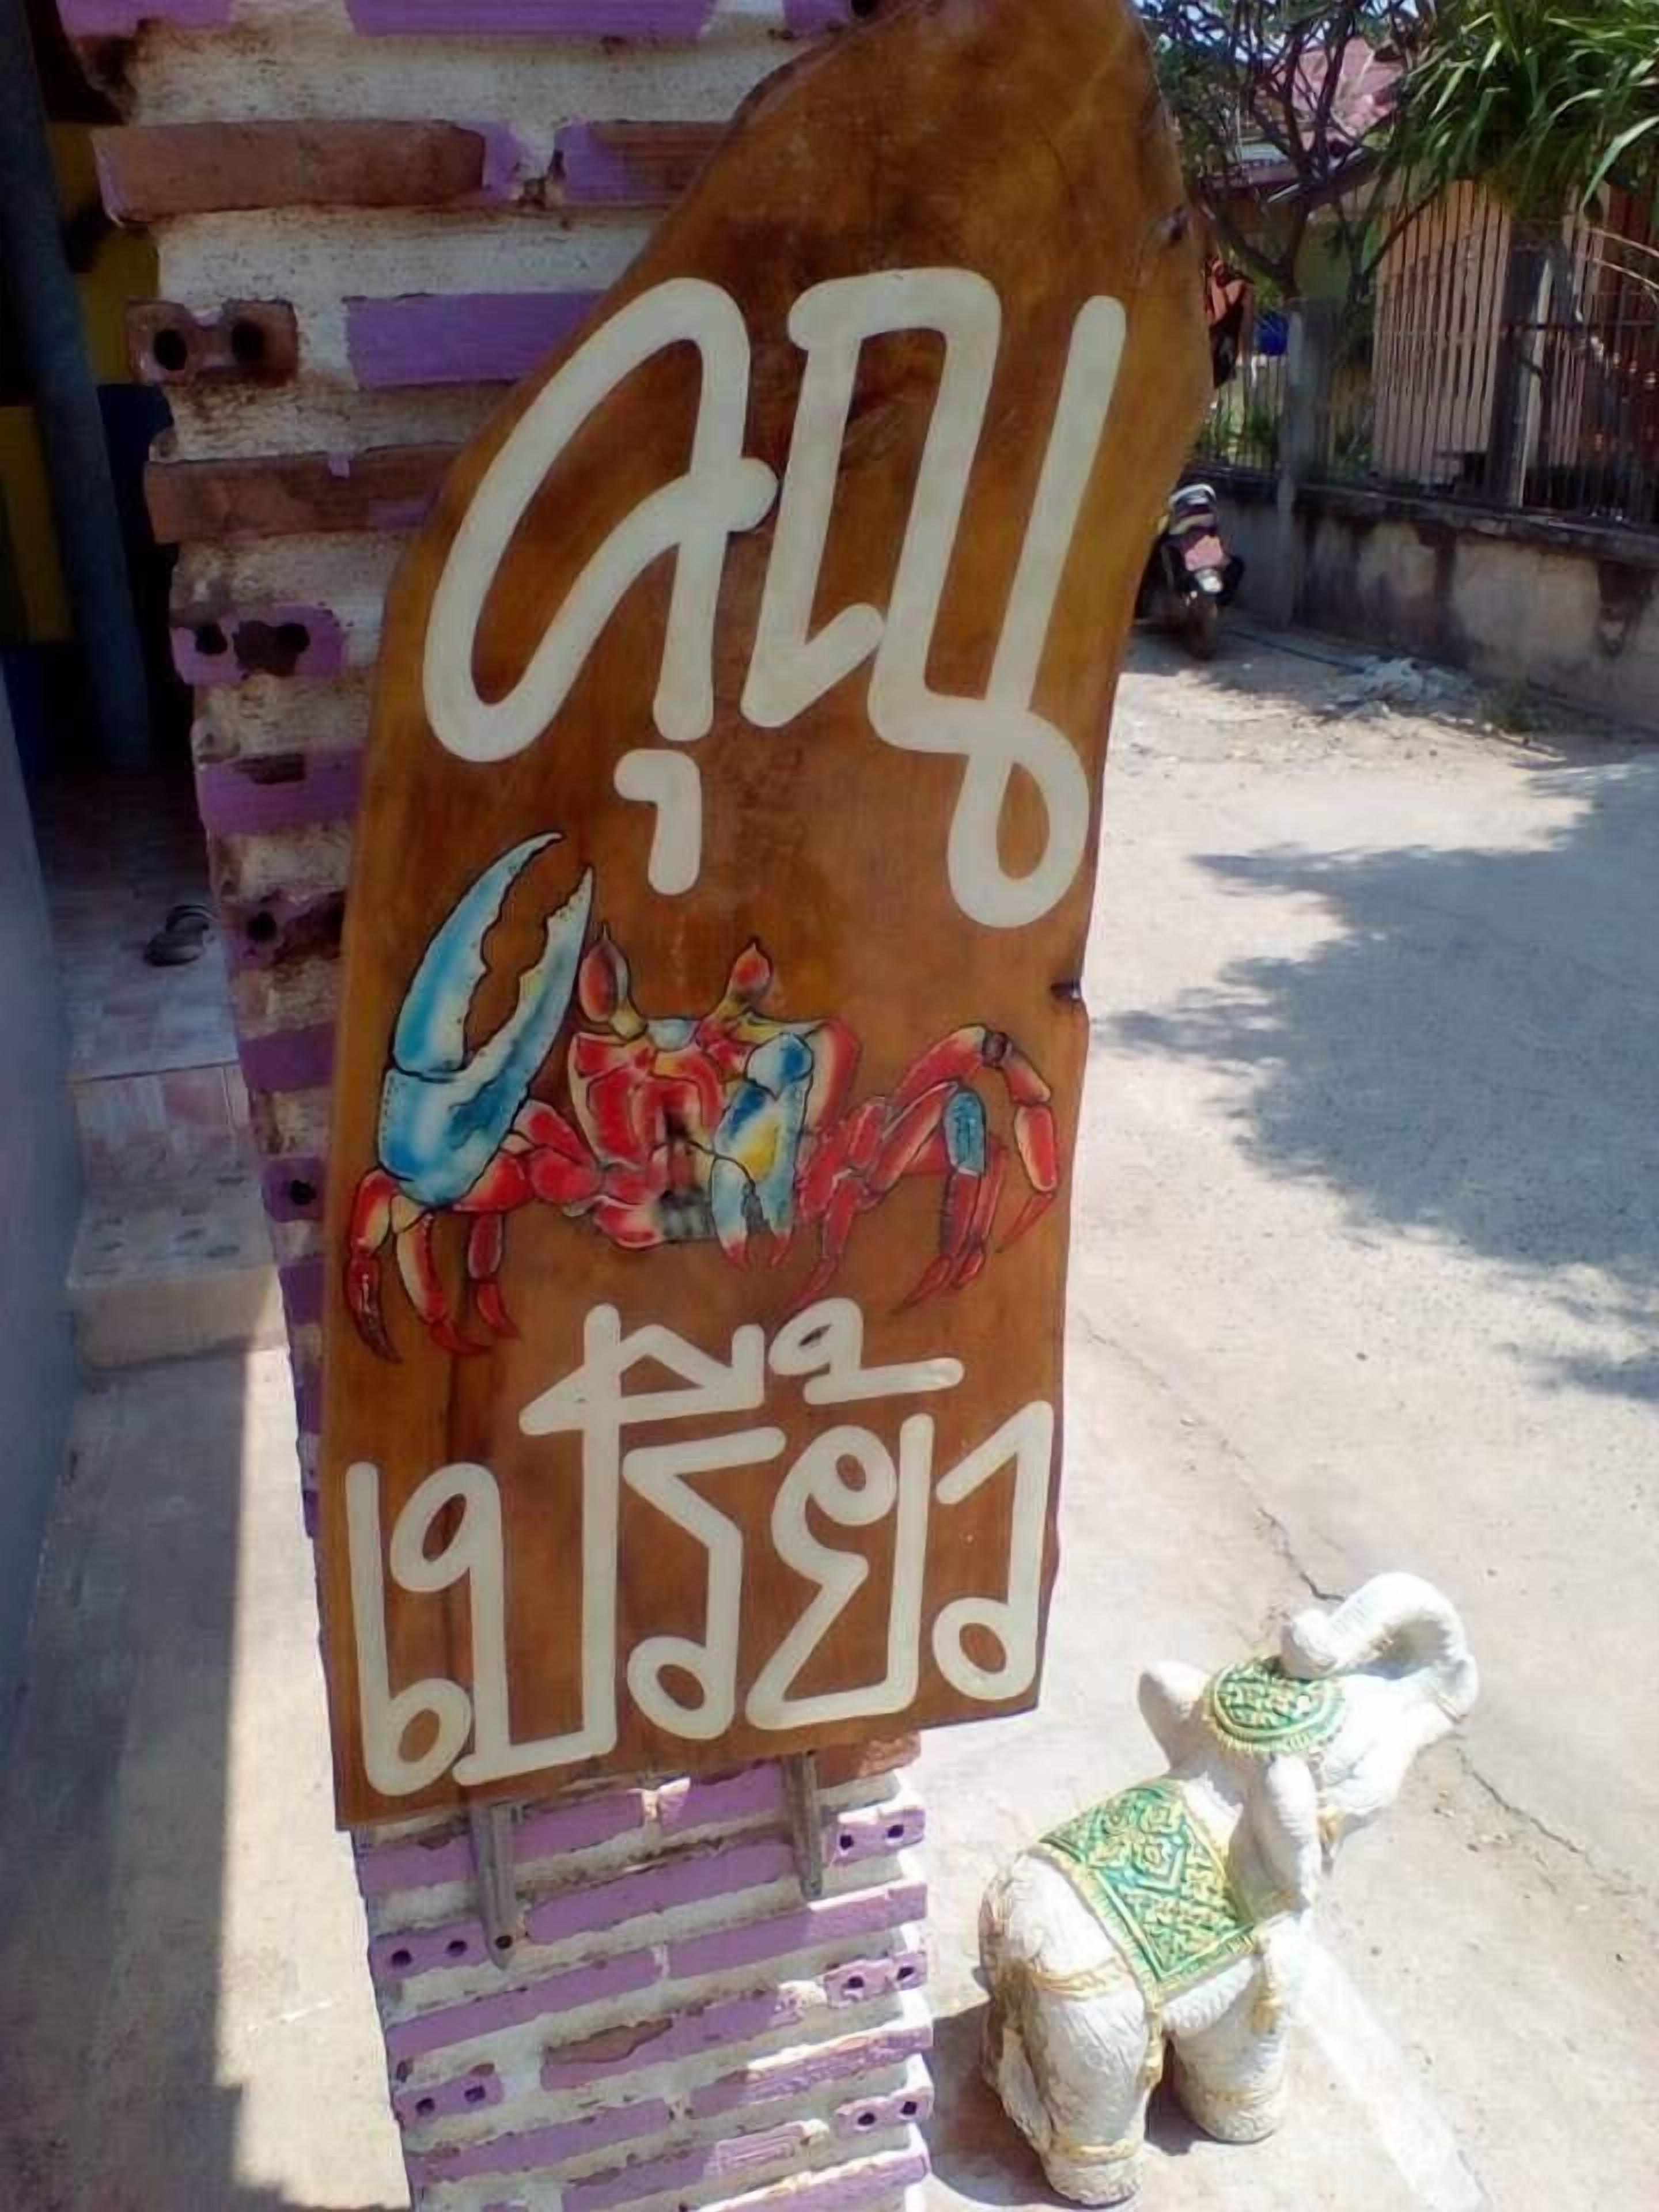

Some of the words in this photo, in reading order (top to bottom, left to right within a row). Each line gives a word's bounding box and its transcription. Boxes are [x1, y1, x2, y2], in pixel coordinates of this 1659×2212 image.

[423, 267, 1127, 929] คุณ
[344, 1297, 1054, 1796] เปรี้ยว
